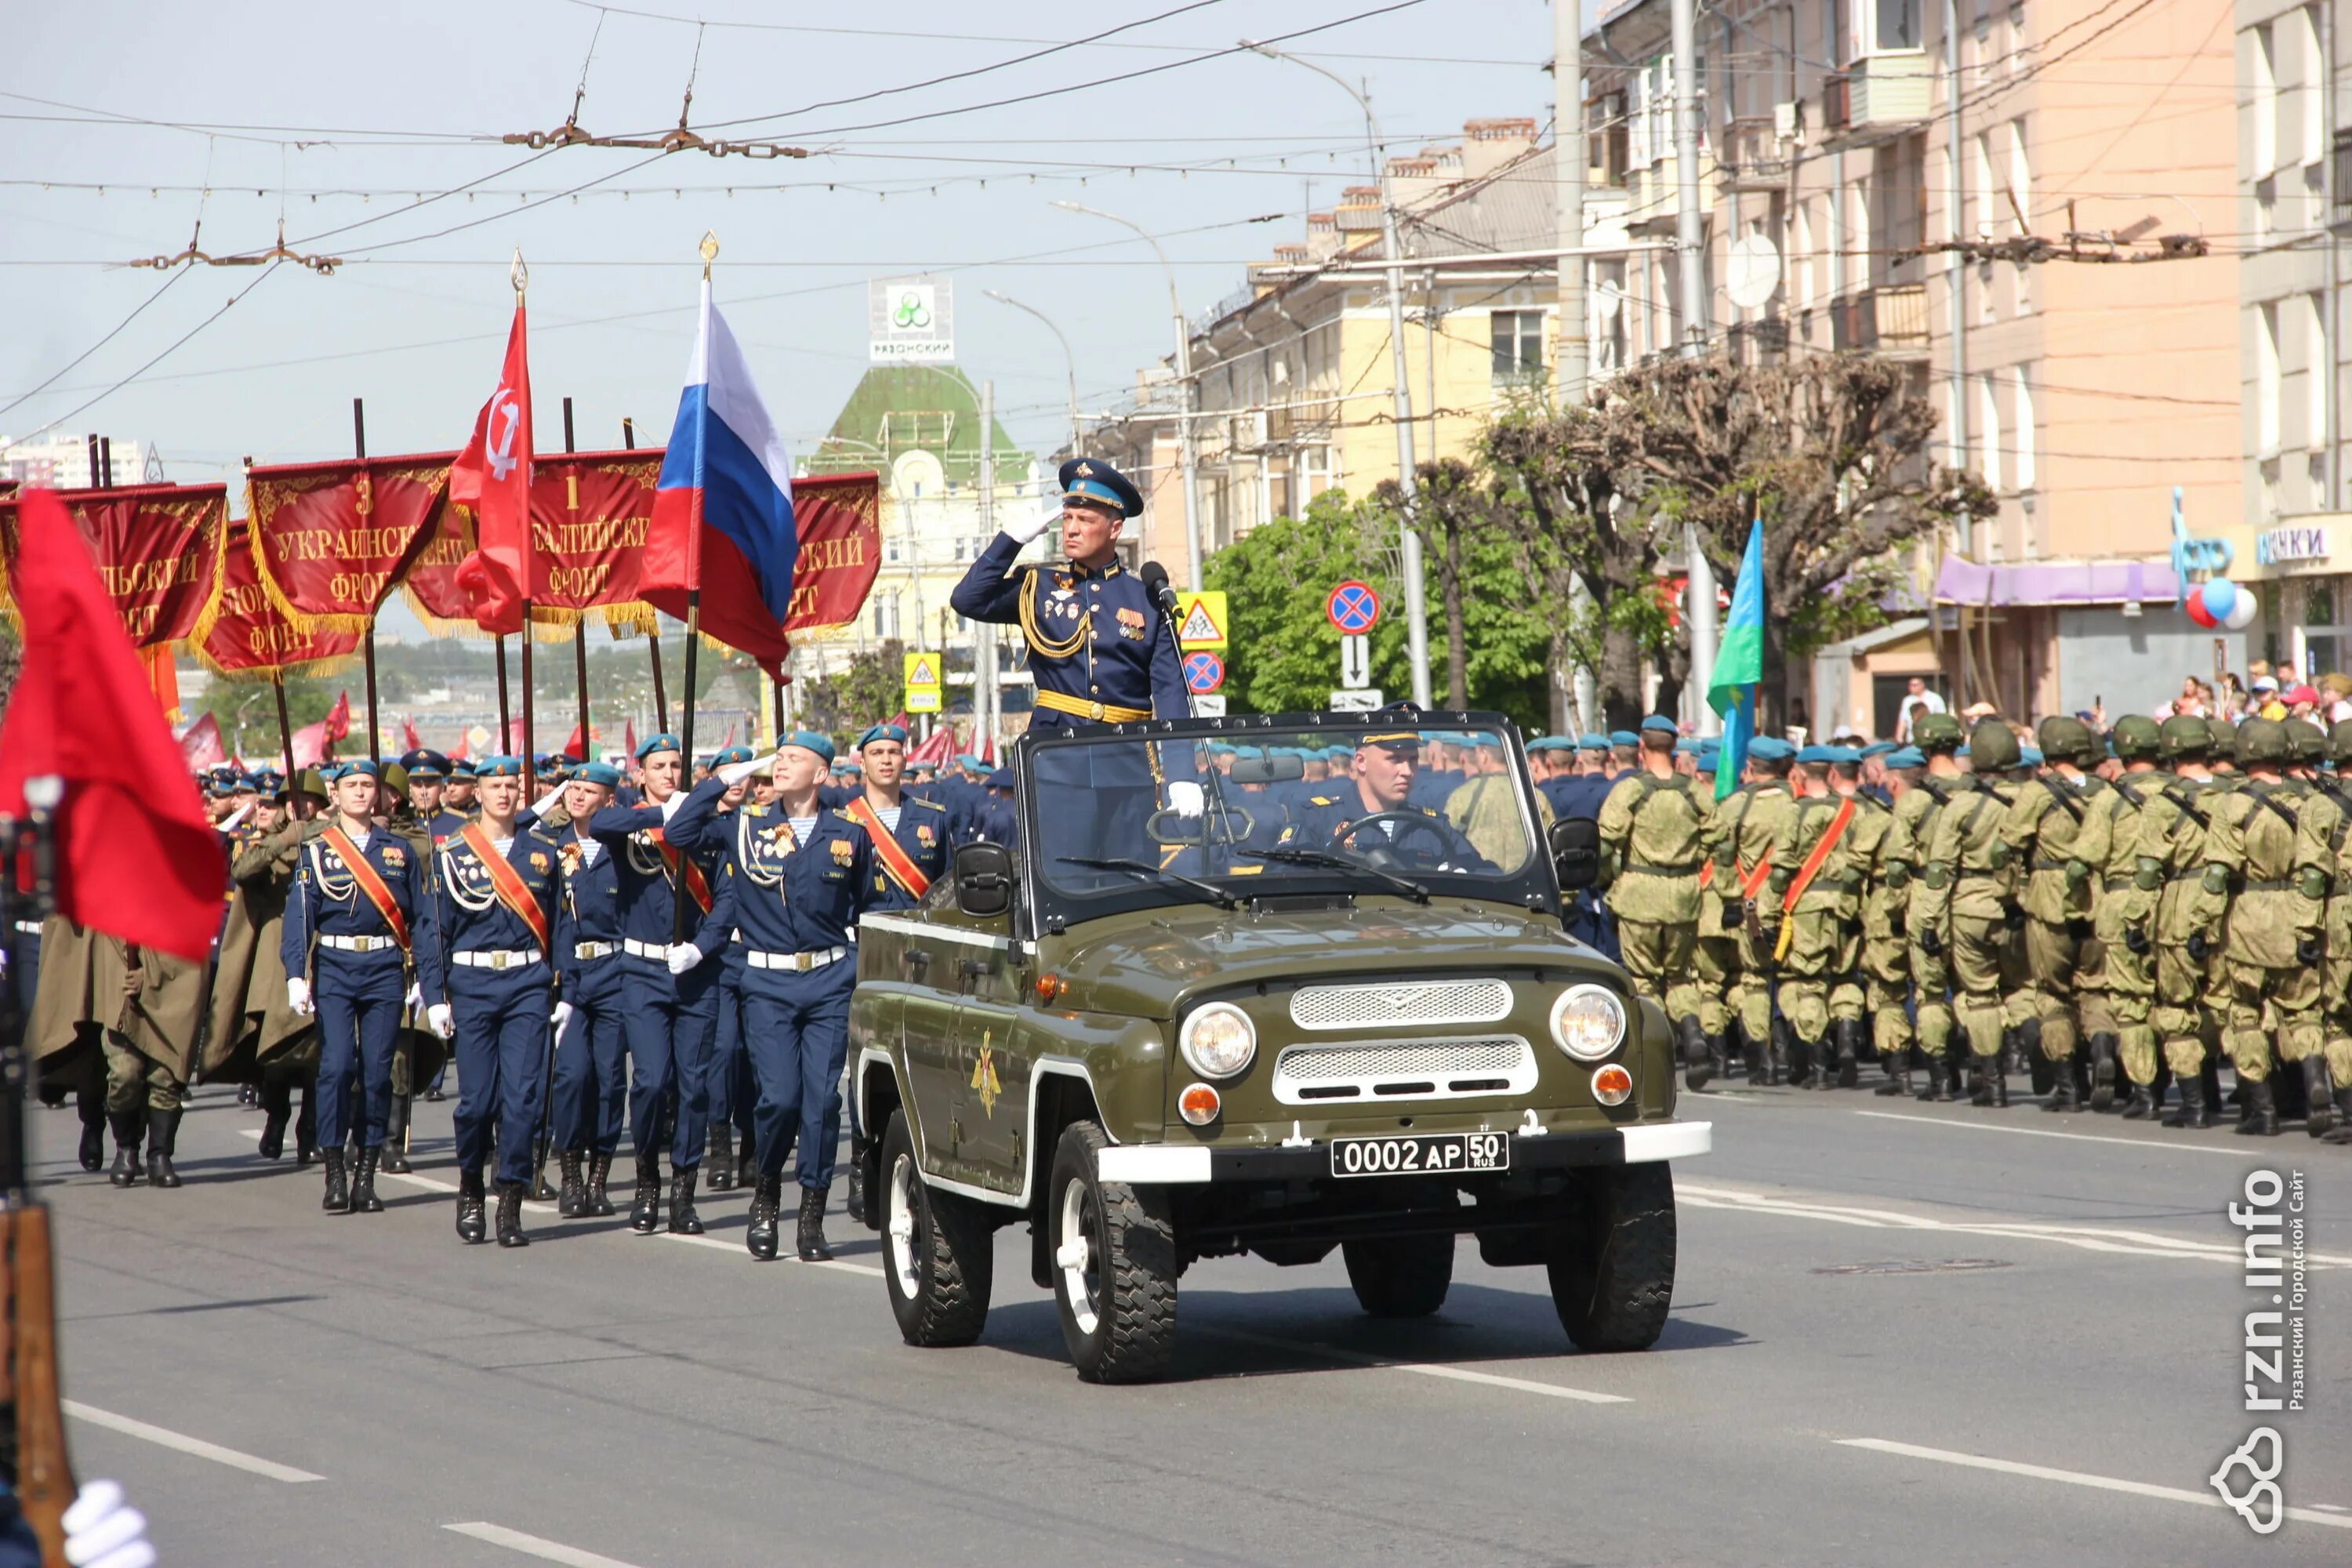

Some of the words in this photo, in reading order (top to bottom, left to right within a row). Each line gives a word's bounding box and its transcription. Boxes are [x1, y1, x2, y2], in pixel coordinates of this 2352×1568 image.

[355, 478, 373, 514] 3
[566, 476, 579, 509] 1
[276, 525, 419, 562] УКРАИНСК
[549, 563, 610, 598] ФРОНТ
[1344, 1140, 1419, 1173] 0002
[1469, 1135, 1499, 1159] 50
[1473, 1158, 1496, 1167] RUS
